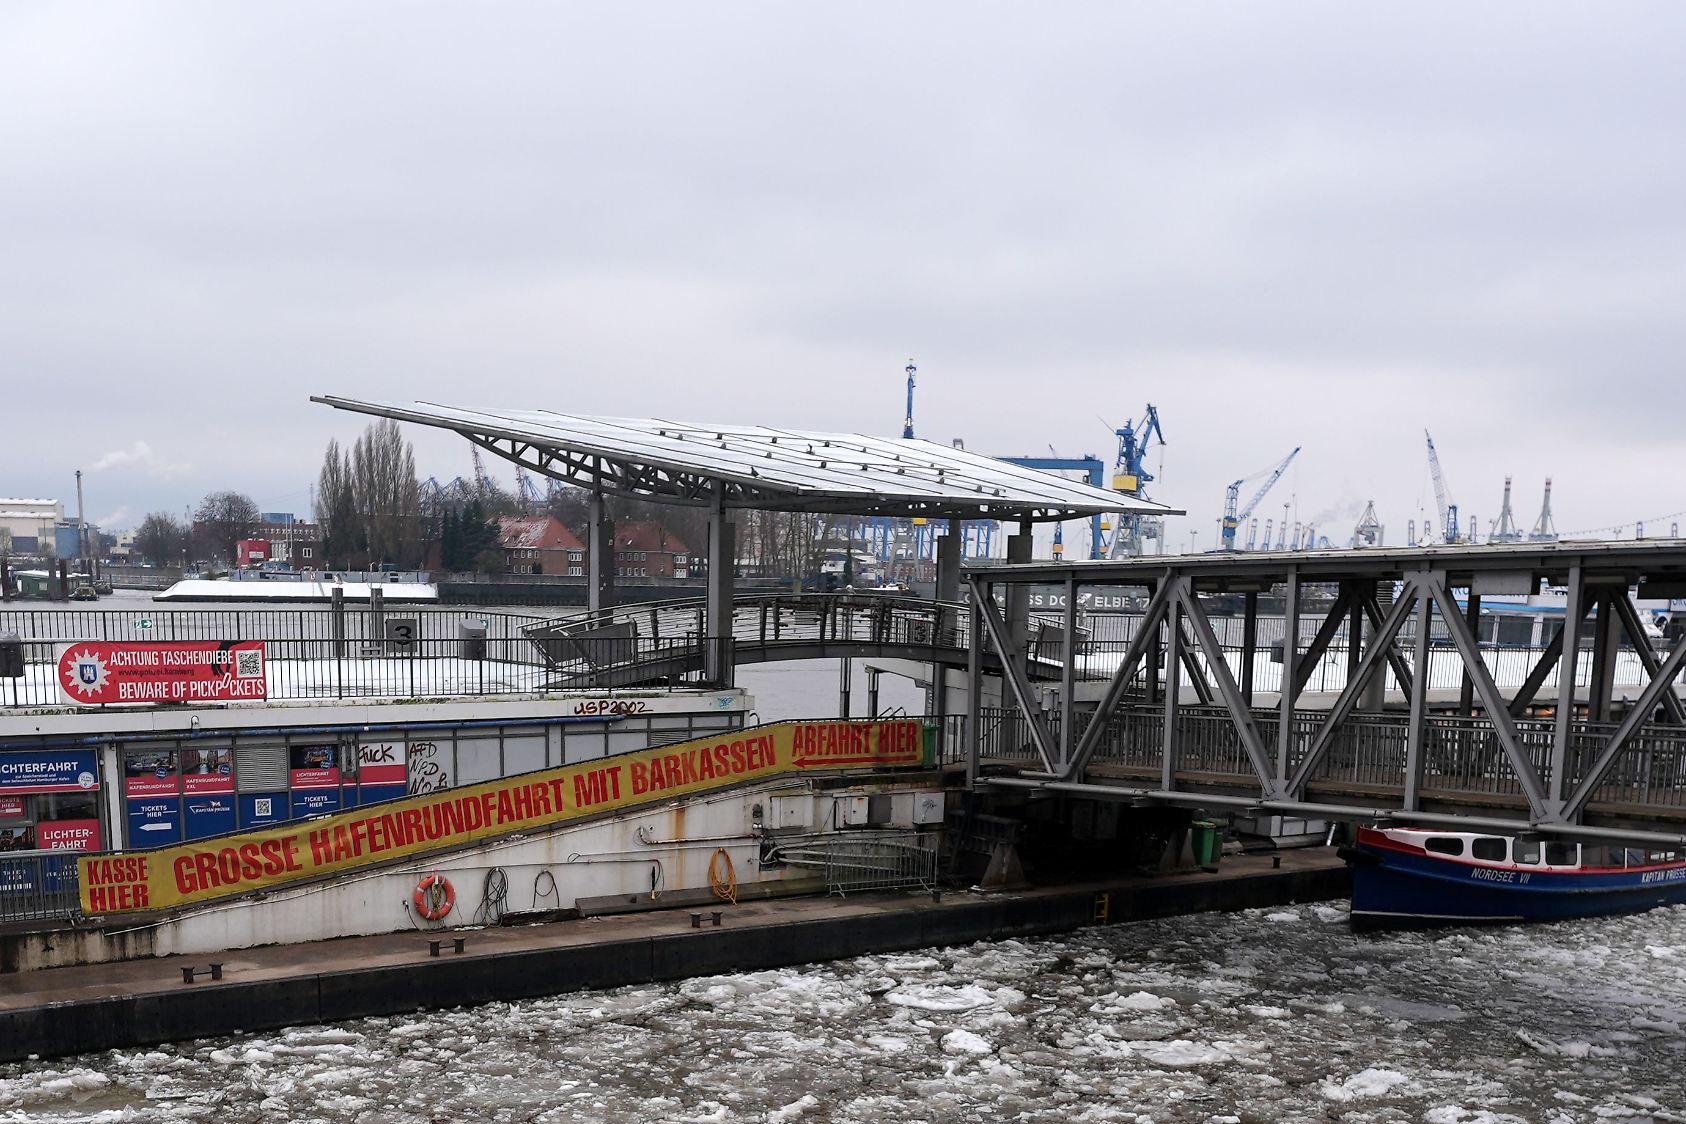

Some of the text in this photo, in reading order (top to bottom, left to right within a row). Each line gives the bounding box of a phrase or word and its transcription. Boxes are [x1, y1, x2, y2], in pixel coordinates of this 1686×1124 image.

[394, 625, 412, 645] 3
[110, 650, 233, 666] ACHTUNG TASCHENDIEBE
[118, 672, 265, 699] BEWARE OF PICKPOCKETS
[791, 722, 918, 757] ABFAHRT HIER
[0, 761, 79, 774] CHTERFAHRT
[304, 795, 328, 803] TICKETS
[141, 804, 168, 812] TICKETS
[173, 734, 777, 895] GROSSE HAFENRUNDFAHRT MIT BARKASSEN
[44, 829, 94, 840] LICHTER-
[51, 840, 88, 850] FAHRT
[87, 856, 149, 886] KASSE
[1471, 867, 1531, 884] NORDSEE VII
[89, 884, 149, 913] HIER
